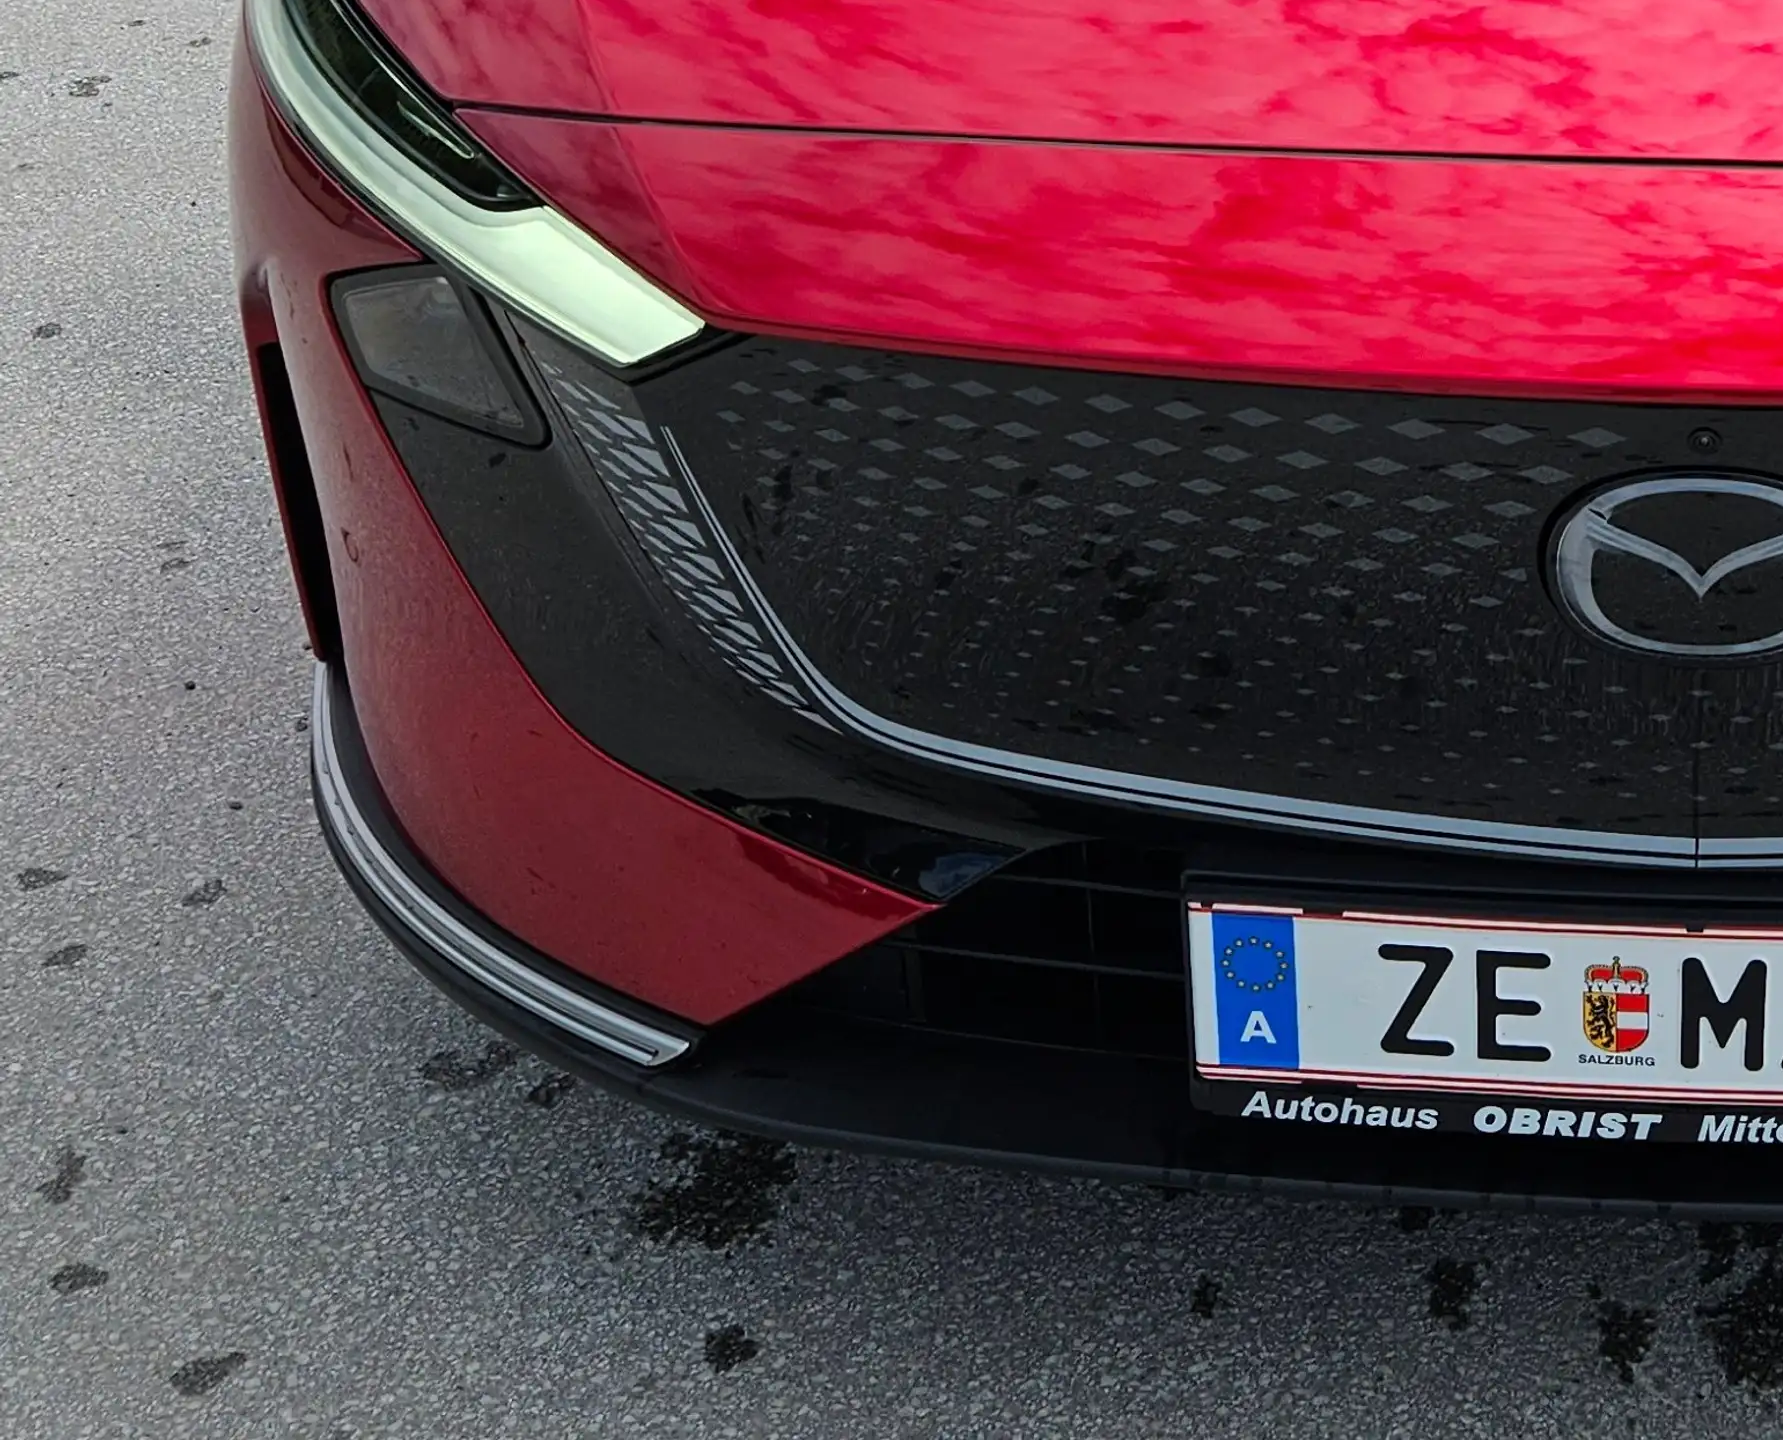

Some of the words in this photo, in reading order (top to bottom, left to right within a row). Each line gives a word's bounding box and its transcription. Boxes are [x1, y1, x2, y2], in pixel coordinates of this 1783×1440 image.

[1377, 943, 1552, 1062] ZE
[1240, 1010, 1277, 1044] A
[1578, 1053, 1656, 1067] SALZBURG
[1241, 1090, 1439, 1130] Autohaus
[1473, 1105, 1663, 1140] OBRIST
